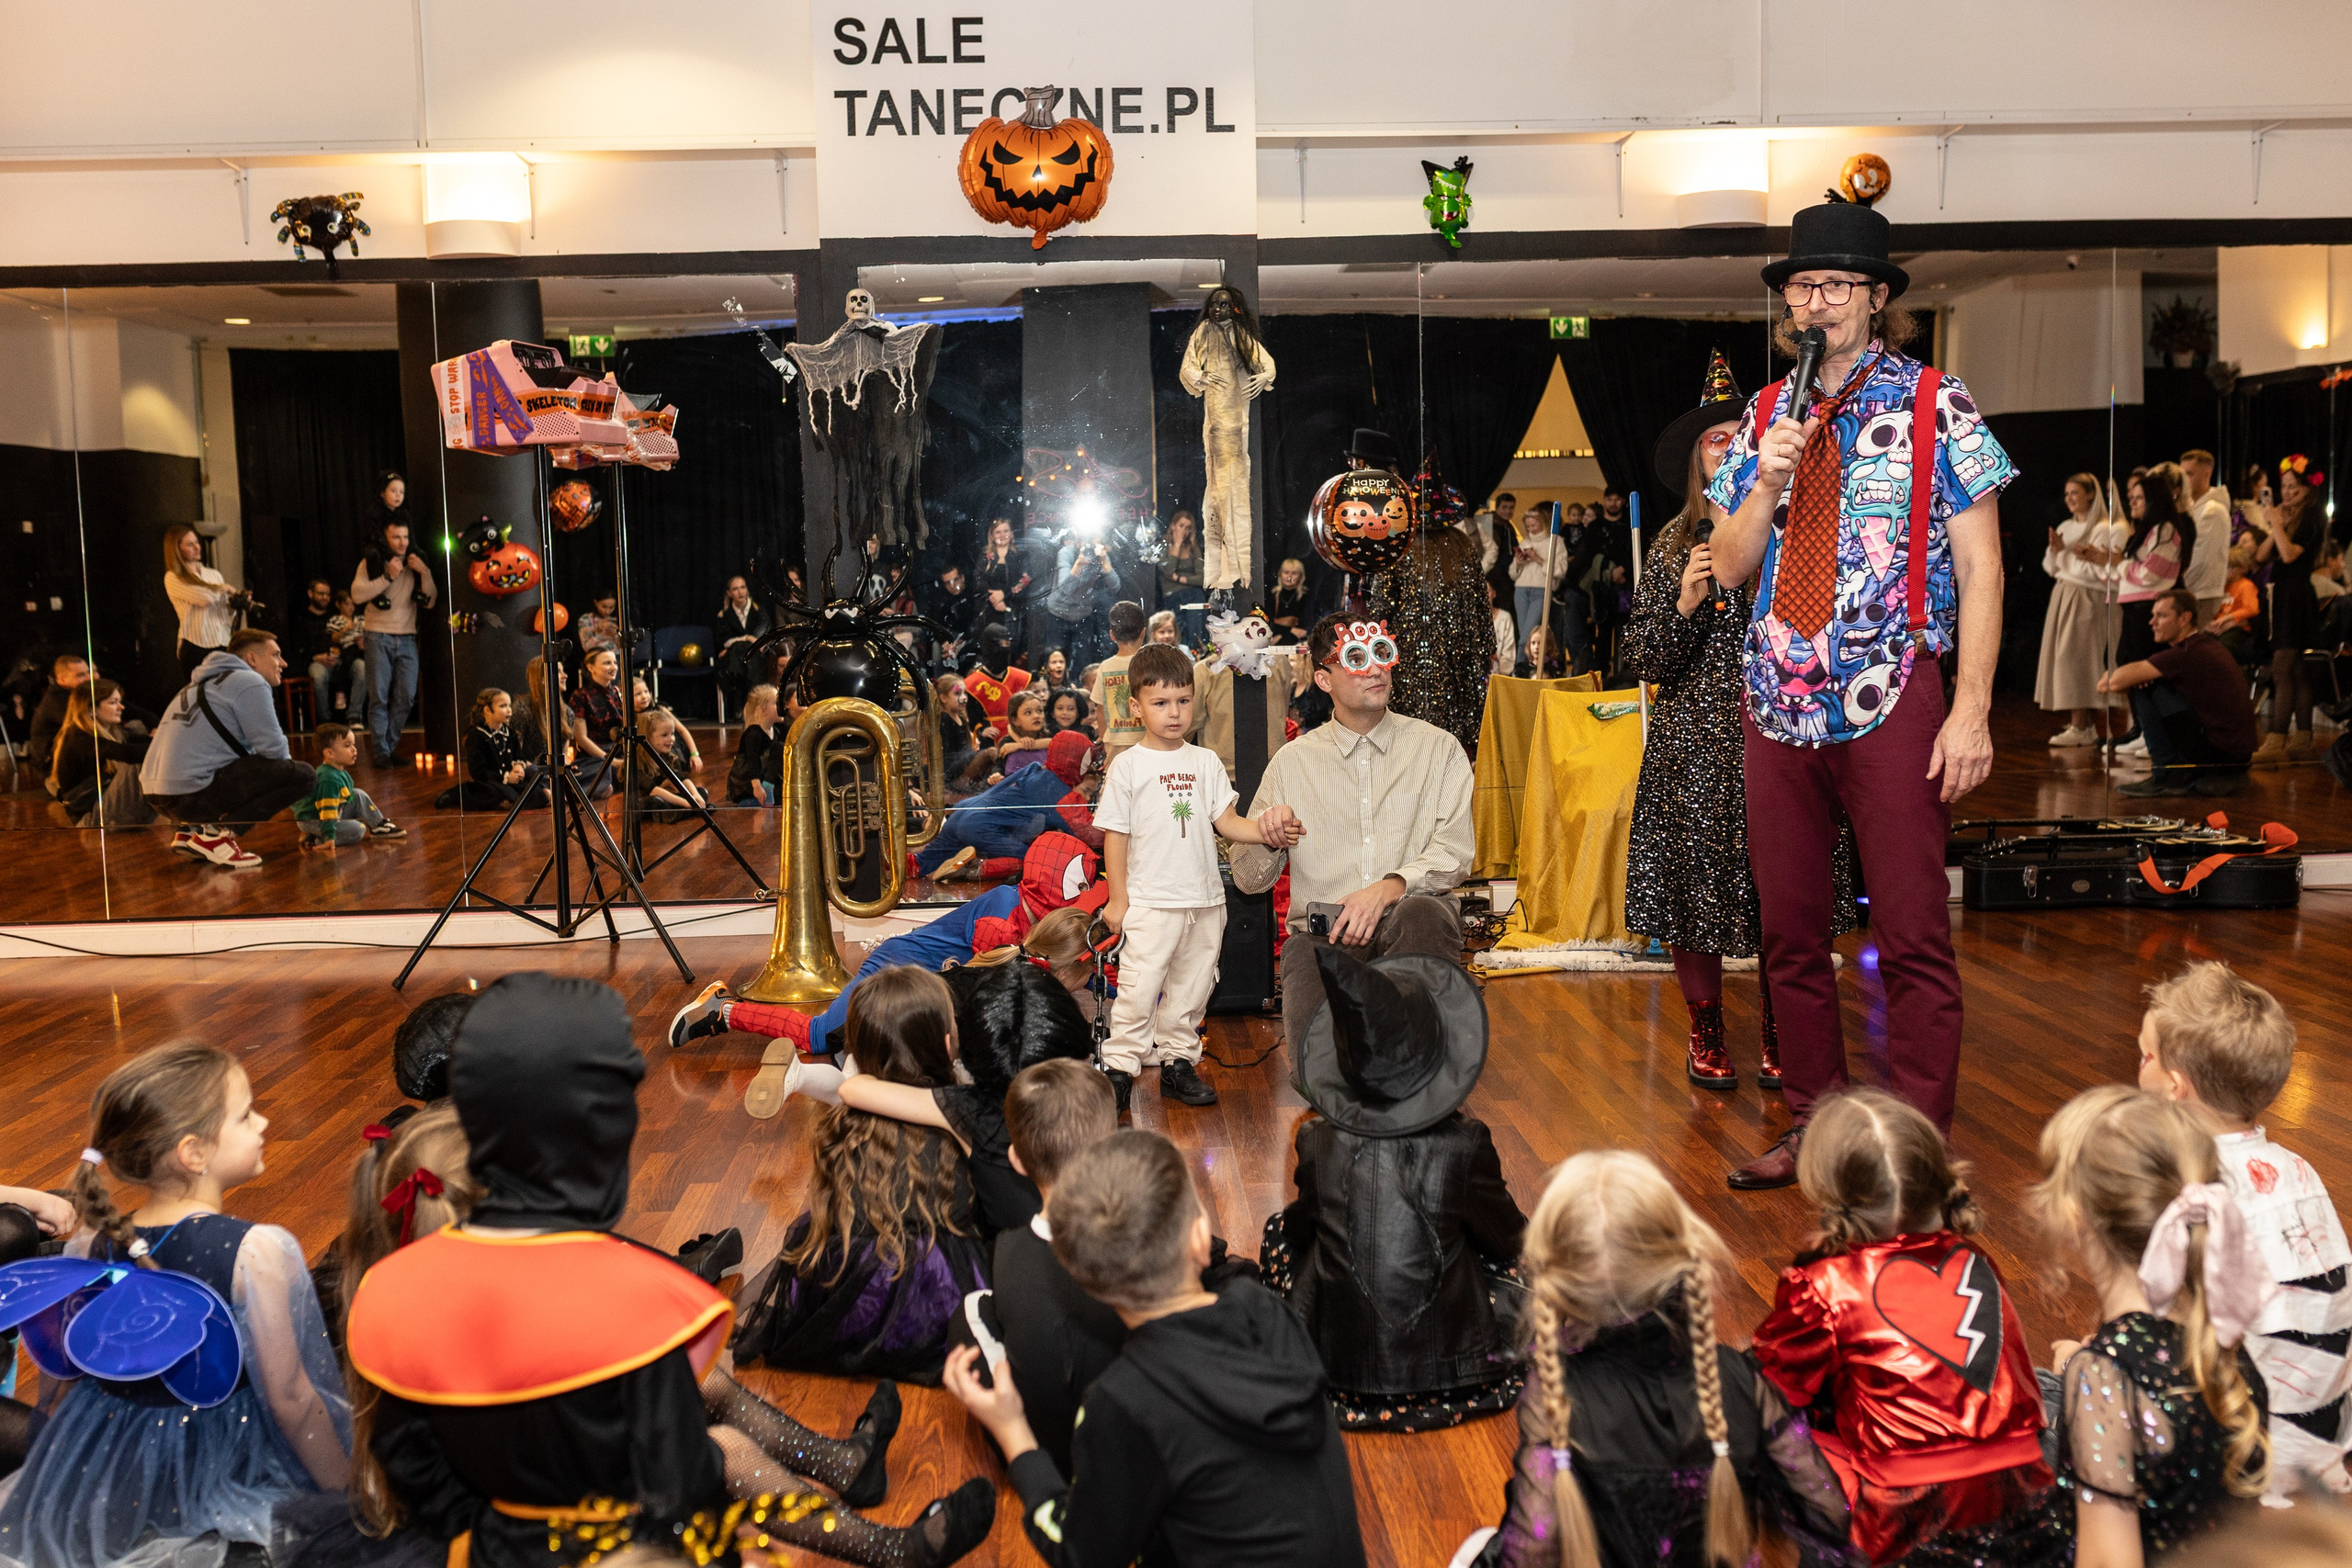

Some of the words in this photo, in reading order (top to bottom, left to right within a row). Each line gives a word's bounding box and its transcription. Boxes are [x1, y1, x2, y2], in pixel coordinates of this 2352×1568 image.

[833, 17, 986, 65] SALE
[448, 388, 461, 414] STOP
[526, 396, 578, 413] SKELETON
[476, 391, 491, 436] DANGER
[1159, 773, 1176, 784] PALM
[1178, 773, 1197, 783] BEACH
[1167, 783, 1193, 792] FLORIDA
